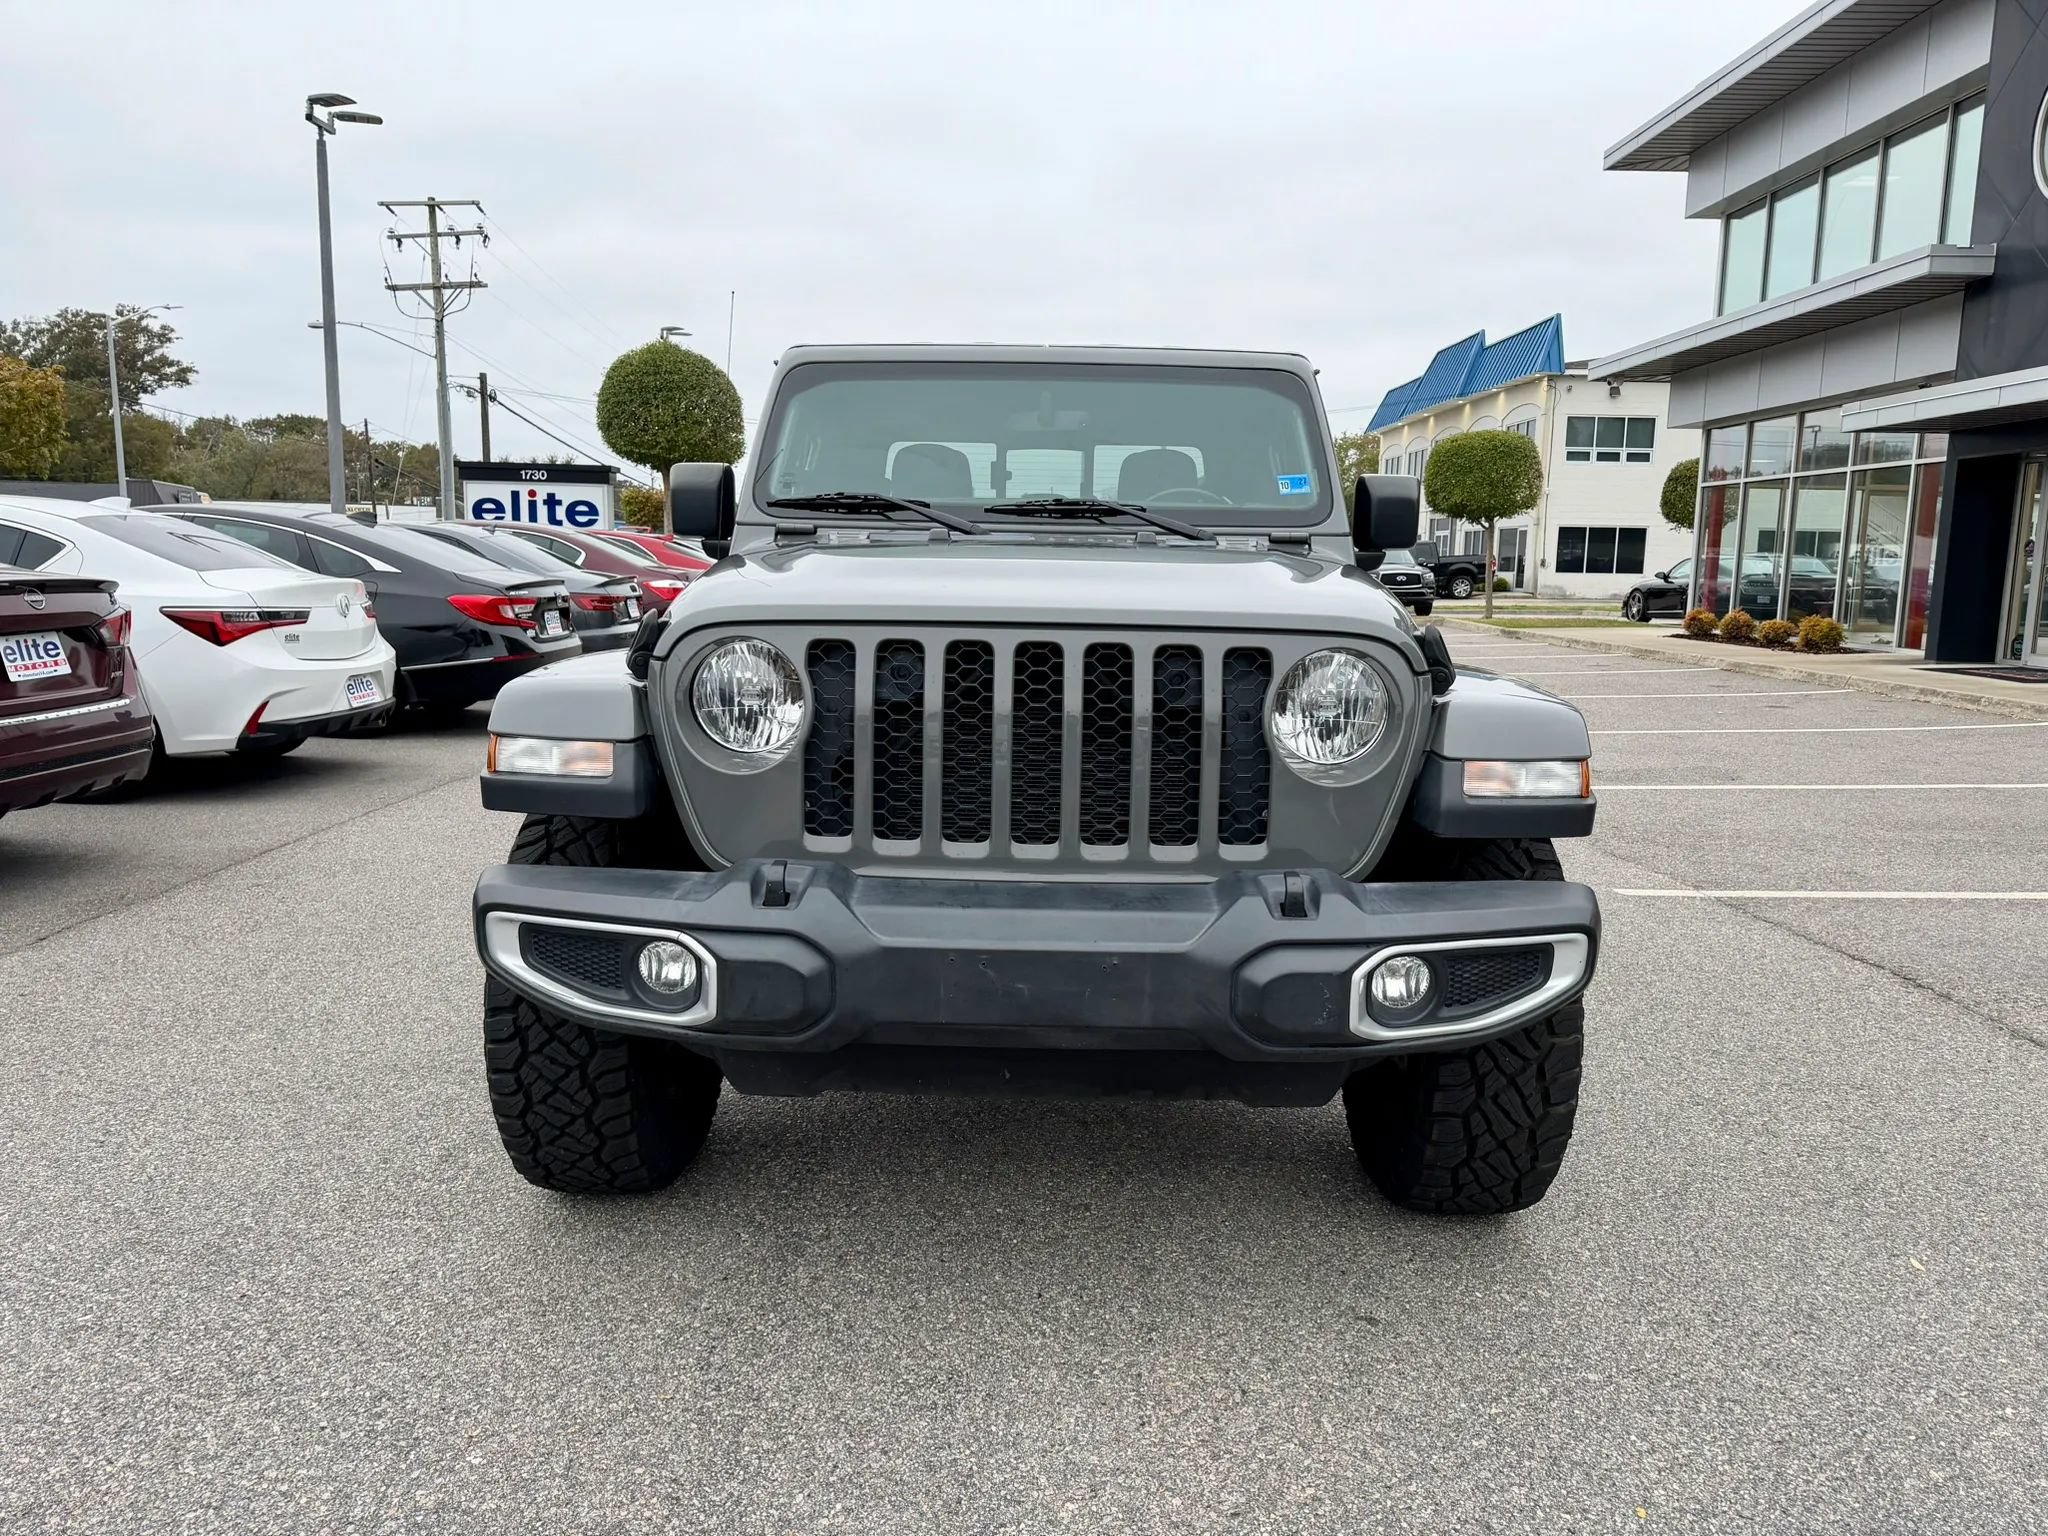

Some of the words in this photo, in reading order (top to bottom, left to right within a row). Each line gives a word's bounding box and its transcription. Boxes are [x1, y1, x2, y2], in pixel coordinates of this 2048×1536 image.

[520, 469, 548, 480] 1730
[1280, 481, 1290, 490] 10
[471, 488, 600, 528] elite
[546, 611, 561, 626] elite
[284, 633, 300, 641] elite
[2, 638, 61, 664] elite
[7, 659, 67, 673] MOTORS
[346, 678, 374, 695] elite
